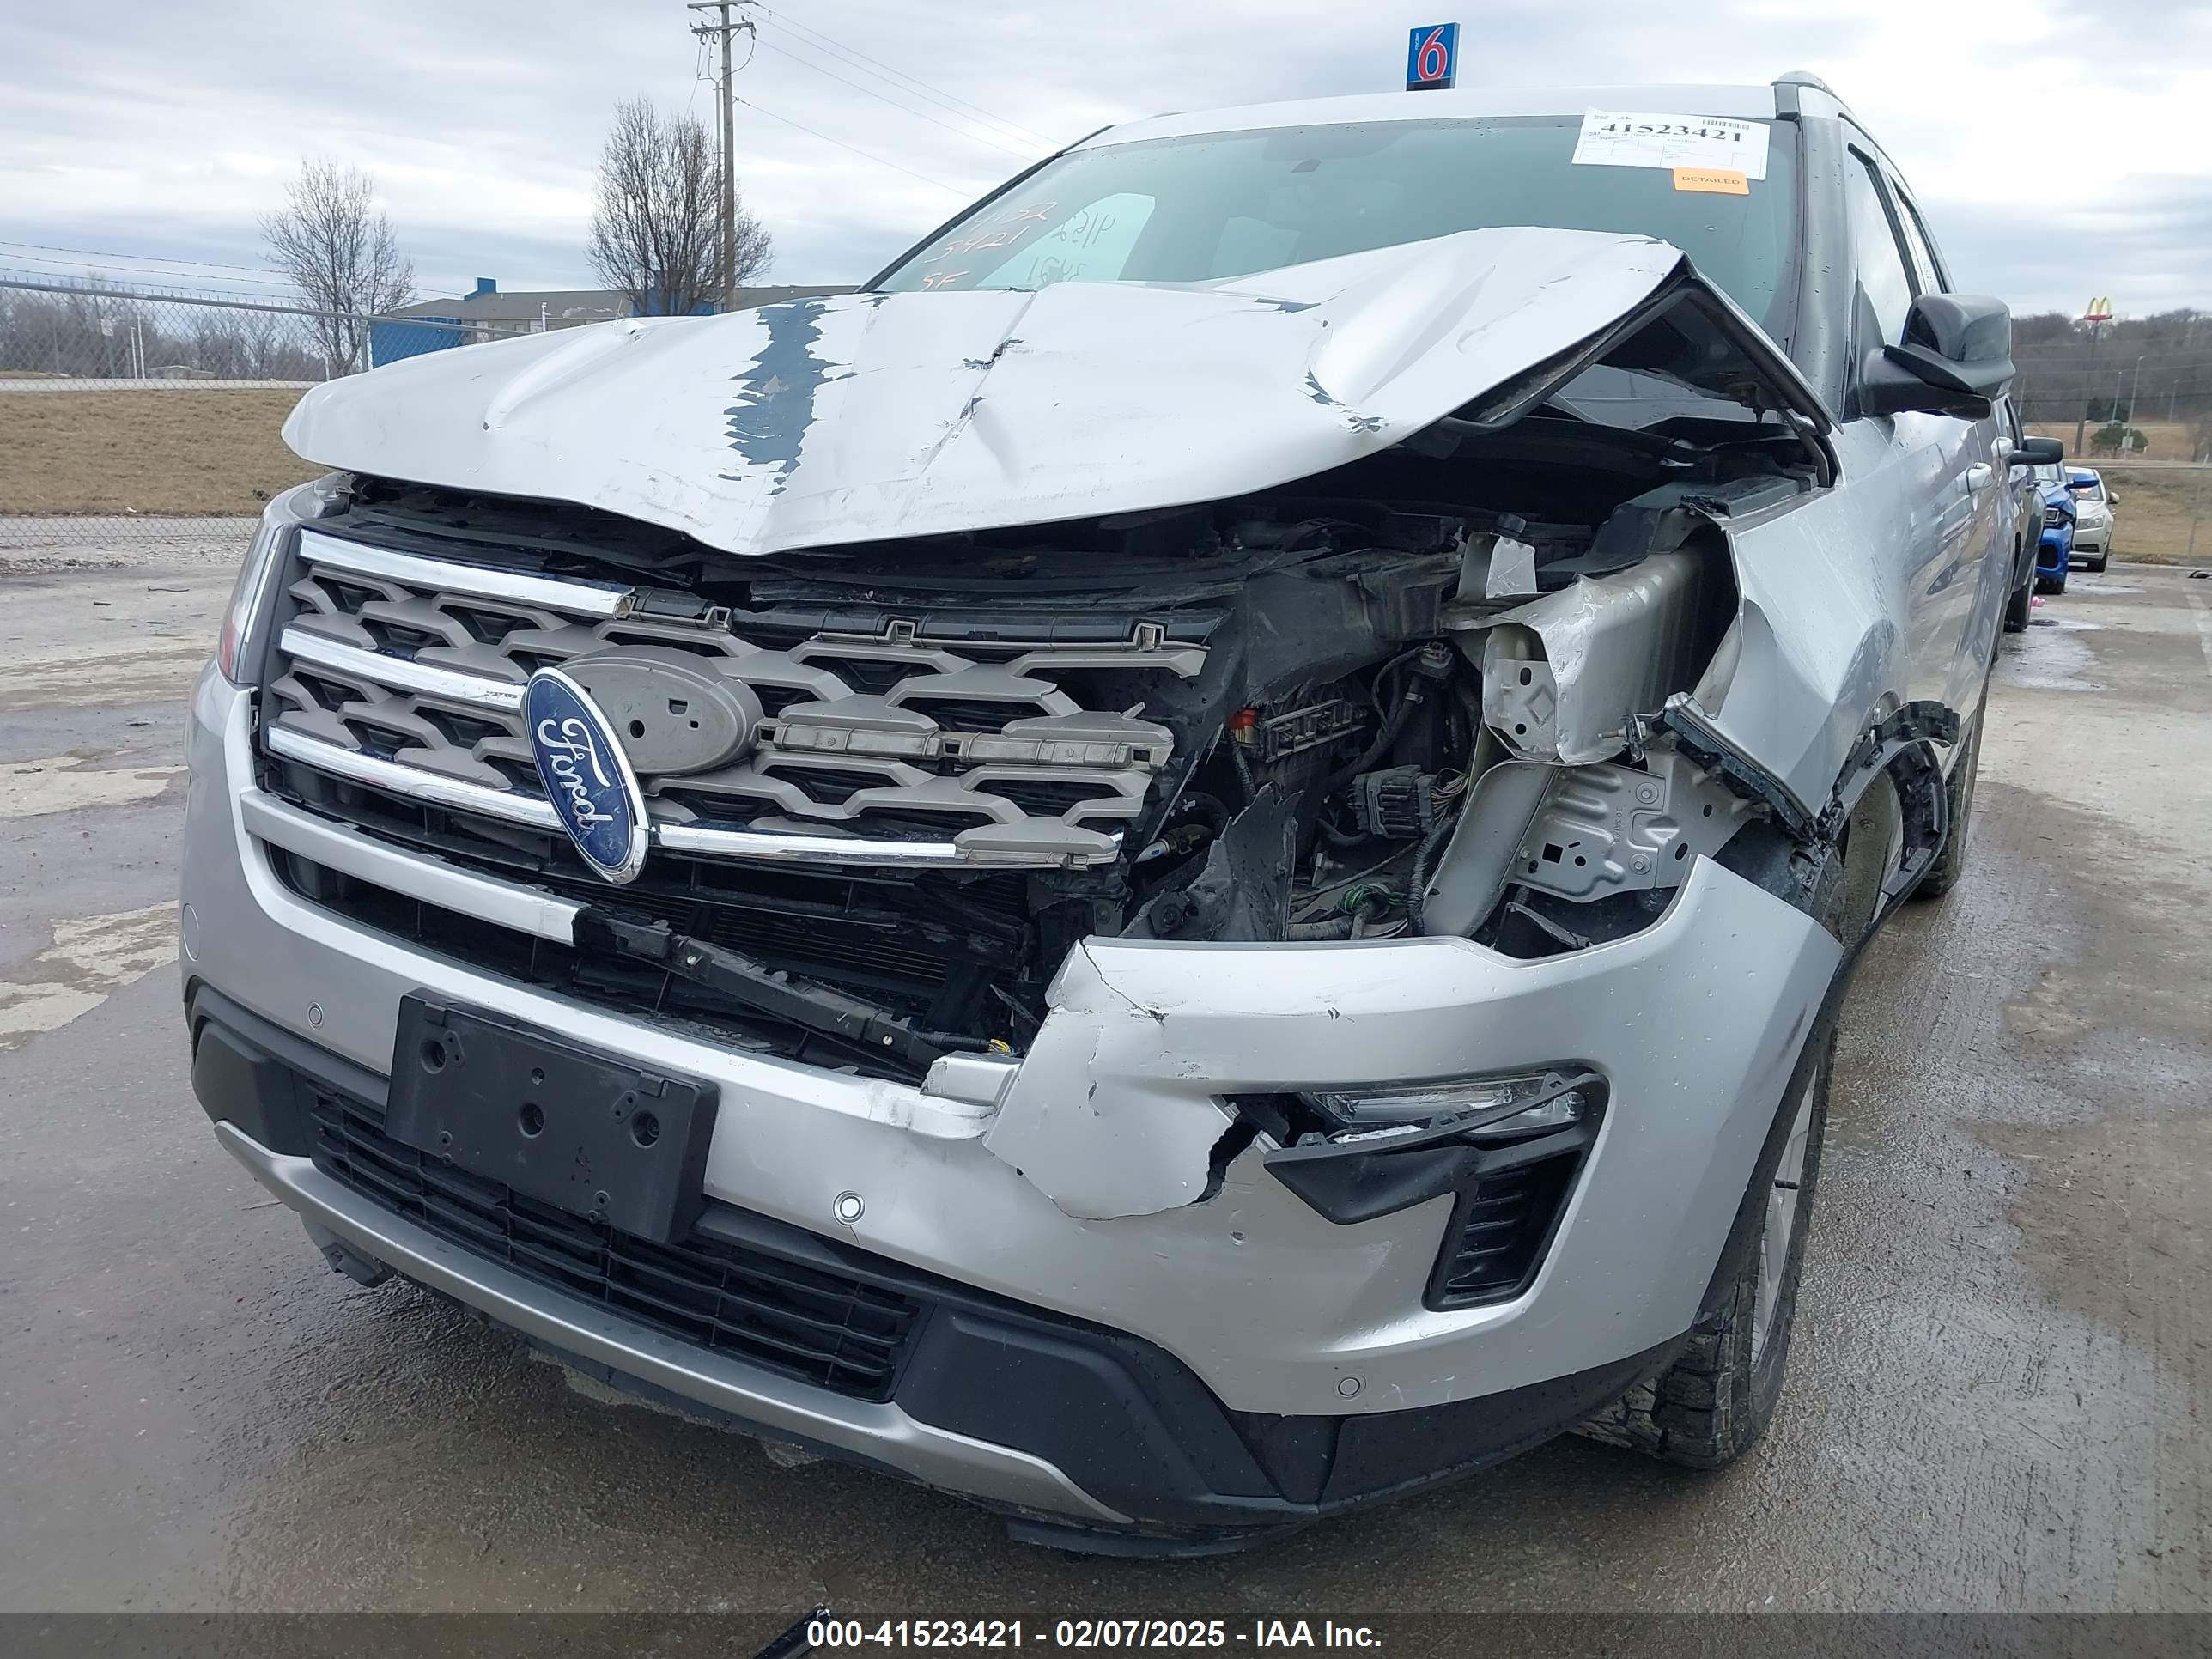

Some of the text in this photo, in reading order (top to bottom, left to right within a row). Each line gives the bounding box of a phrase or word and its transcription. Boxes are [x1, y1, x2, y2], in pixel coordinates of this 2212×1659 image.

[1418, 27, 1448, 81] 6
[1601, 123, 1741, 142] 41523421
[1682, 176, 1740, 185] DETAILED
[538, 718, 614, 843] Ford
